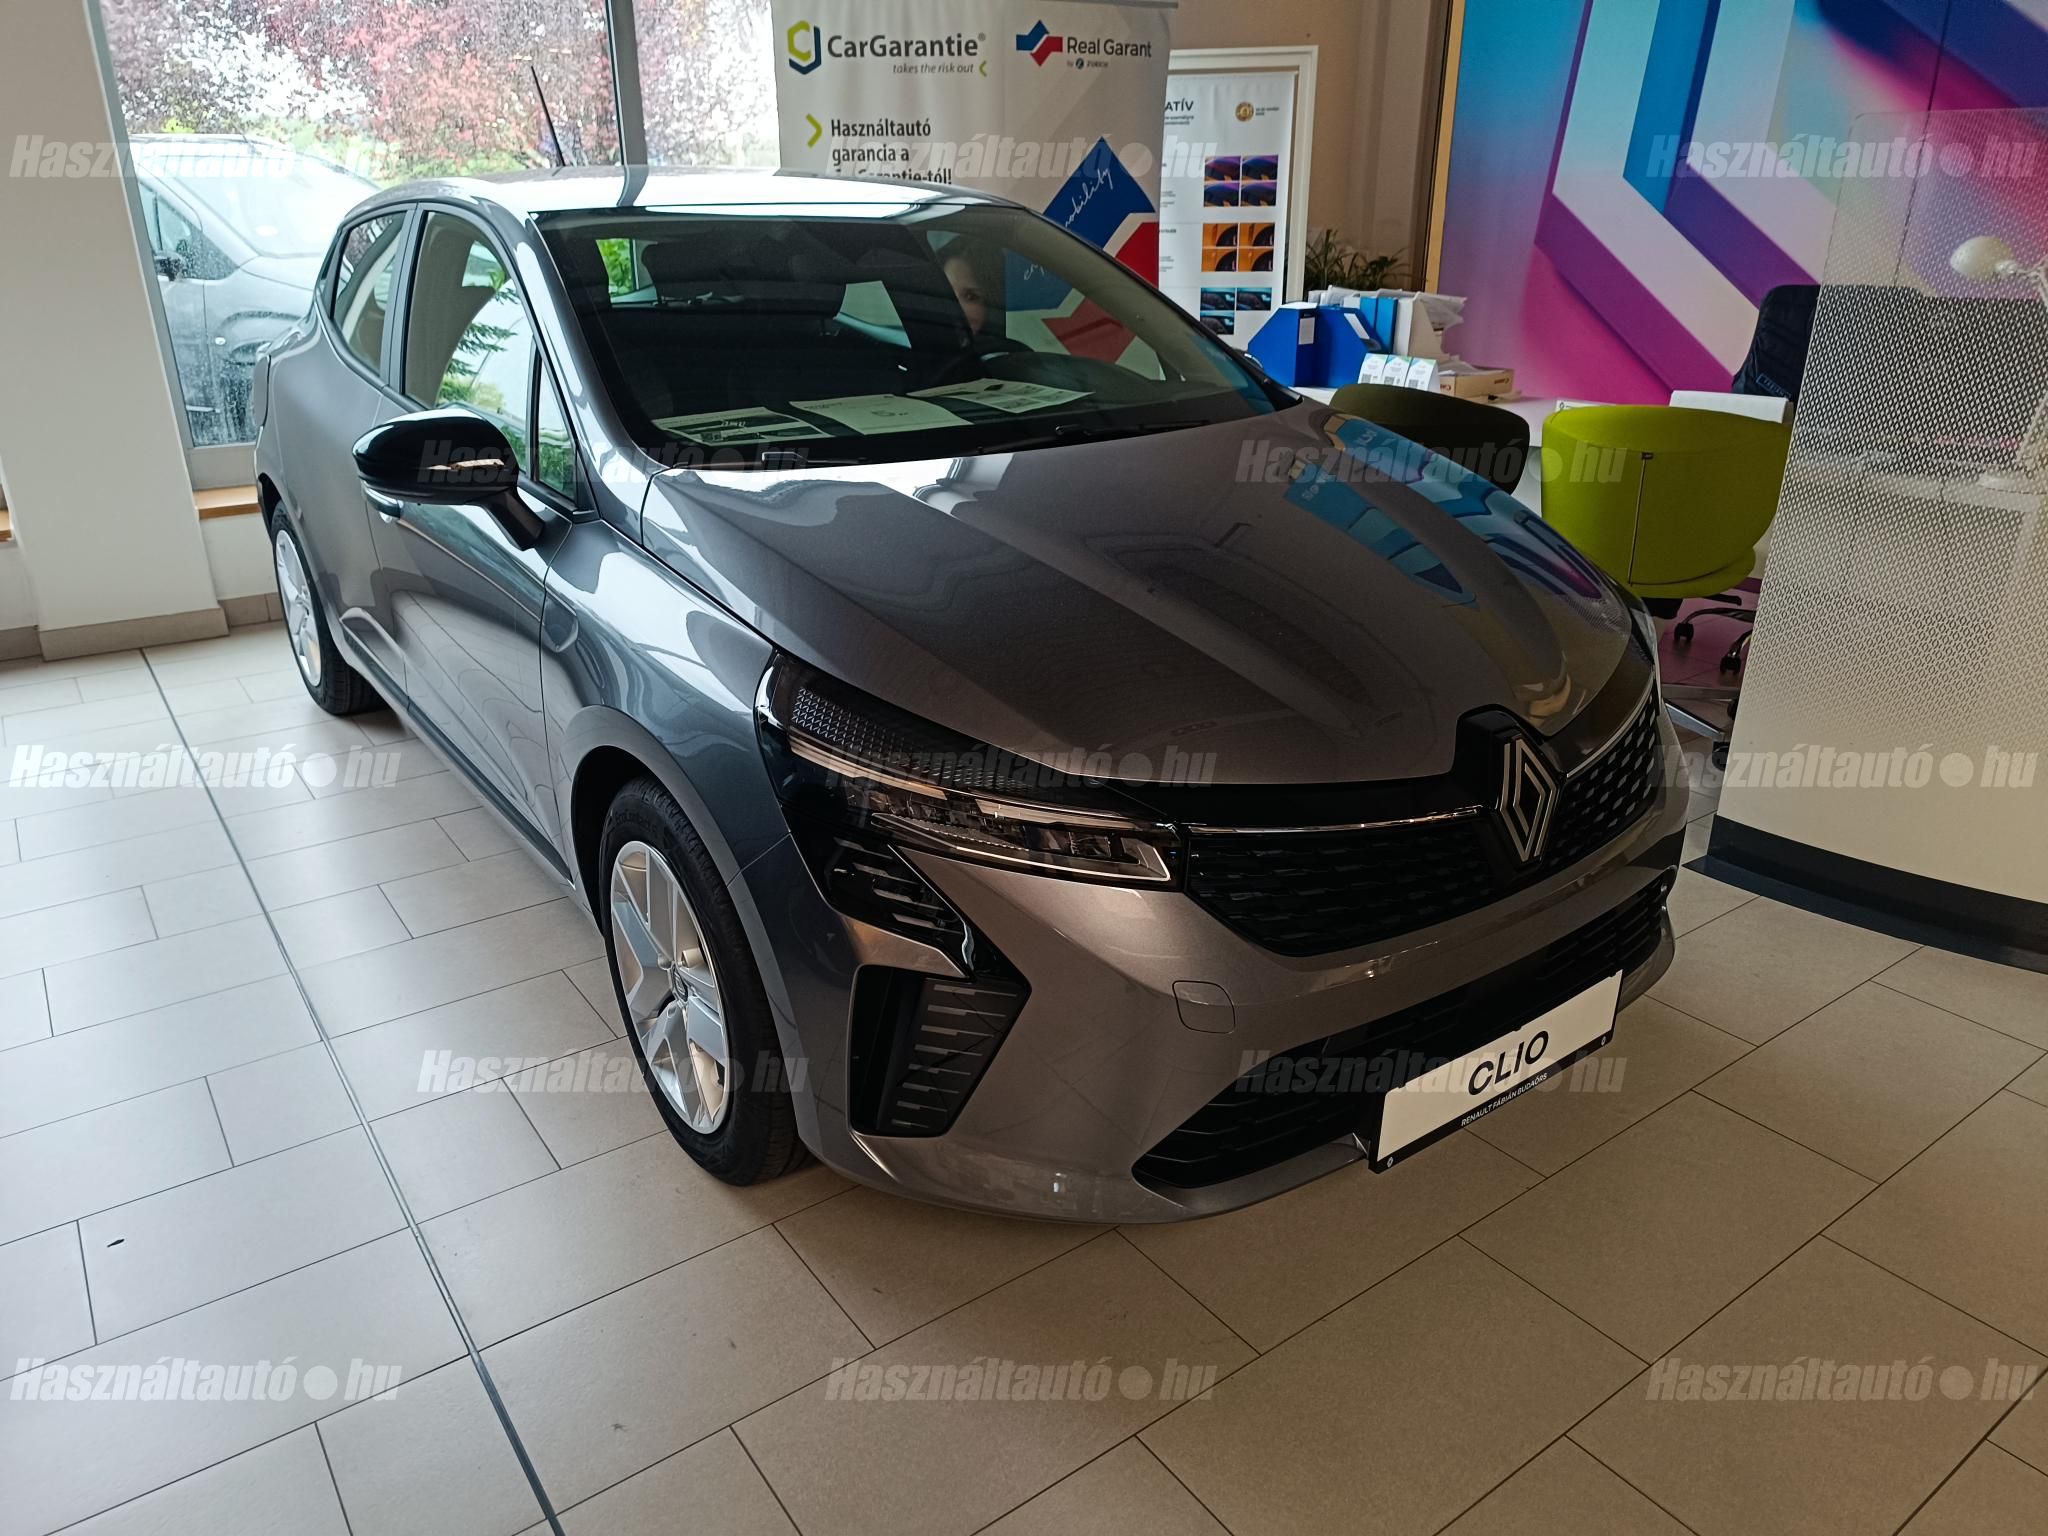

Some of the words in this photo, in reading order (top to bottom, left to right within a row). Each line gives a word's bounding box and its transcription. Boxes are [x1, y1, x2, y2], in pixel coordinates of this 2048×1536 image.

[1067, 36, 1100, 55] Real
[1103, 39, 1152, 58] Garant
[893, 63, 918, 73] takes
[920, 62, 937, 73] the
[937, 62, 955, 73] risk
[957, 63, 974, 73] out
[831, 117, 931, 137] Használtautó
[832, 144, 896, 166] garancia
[900, 148, 909, 161] a
[1468, 1030, 1549, 1095] CLIO
[1461, 1104, 1493, 1127] RENAULT
